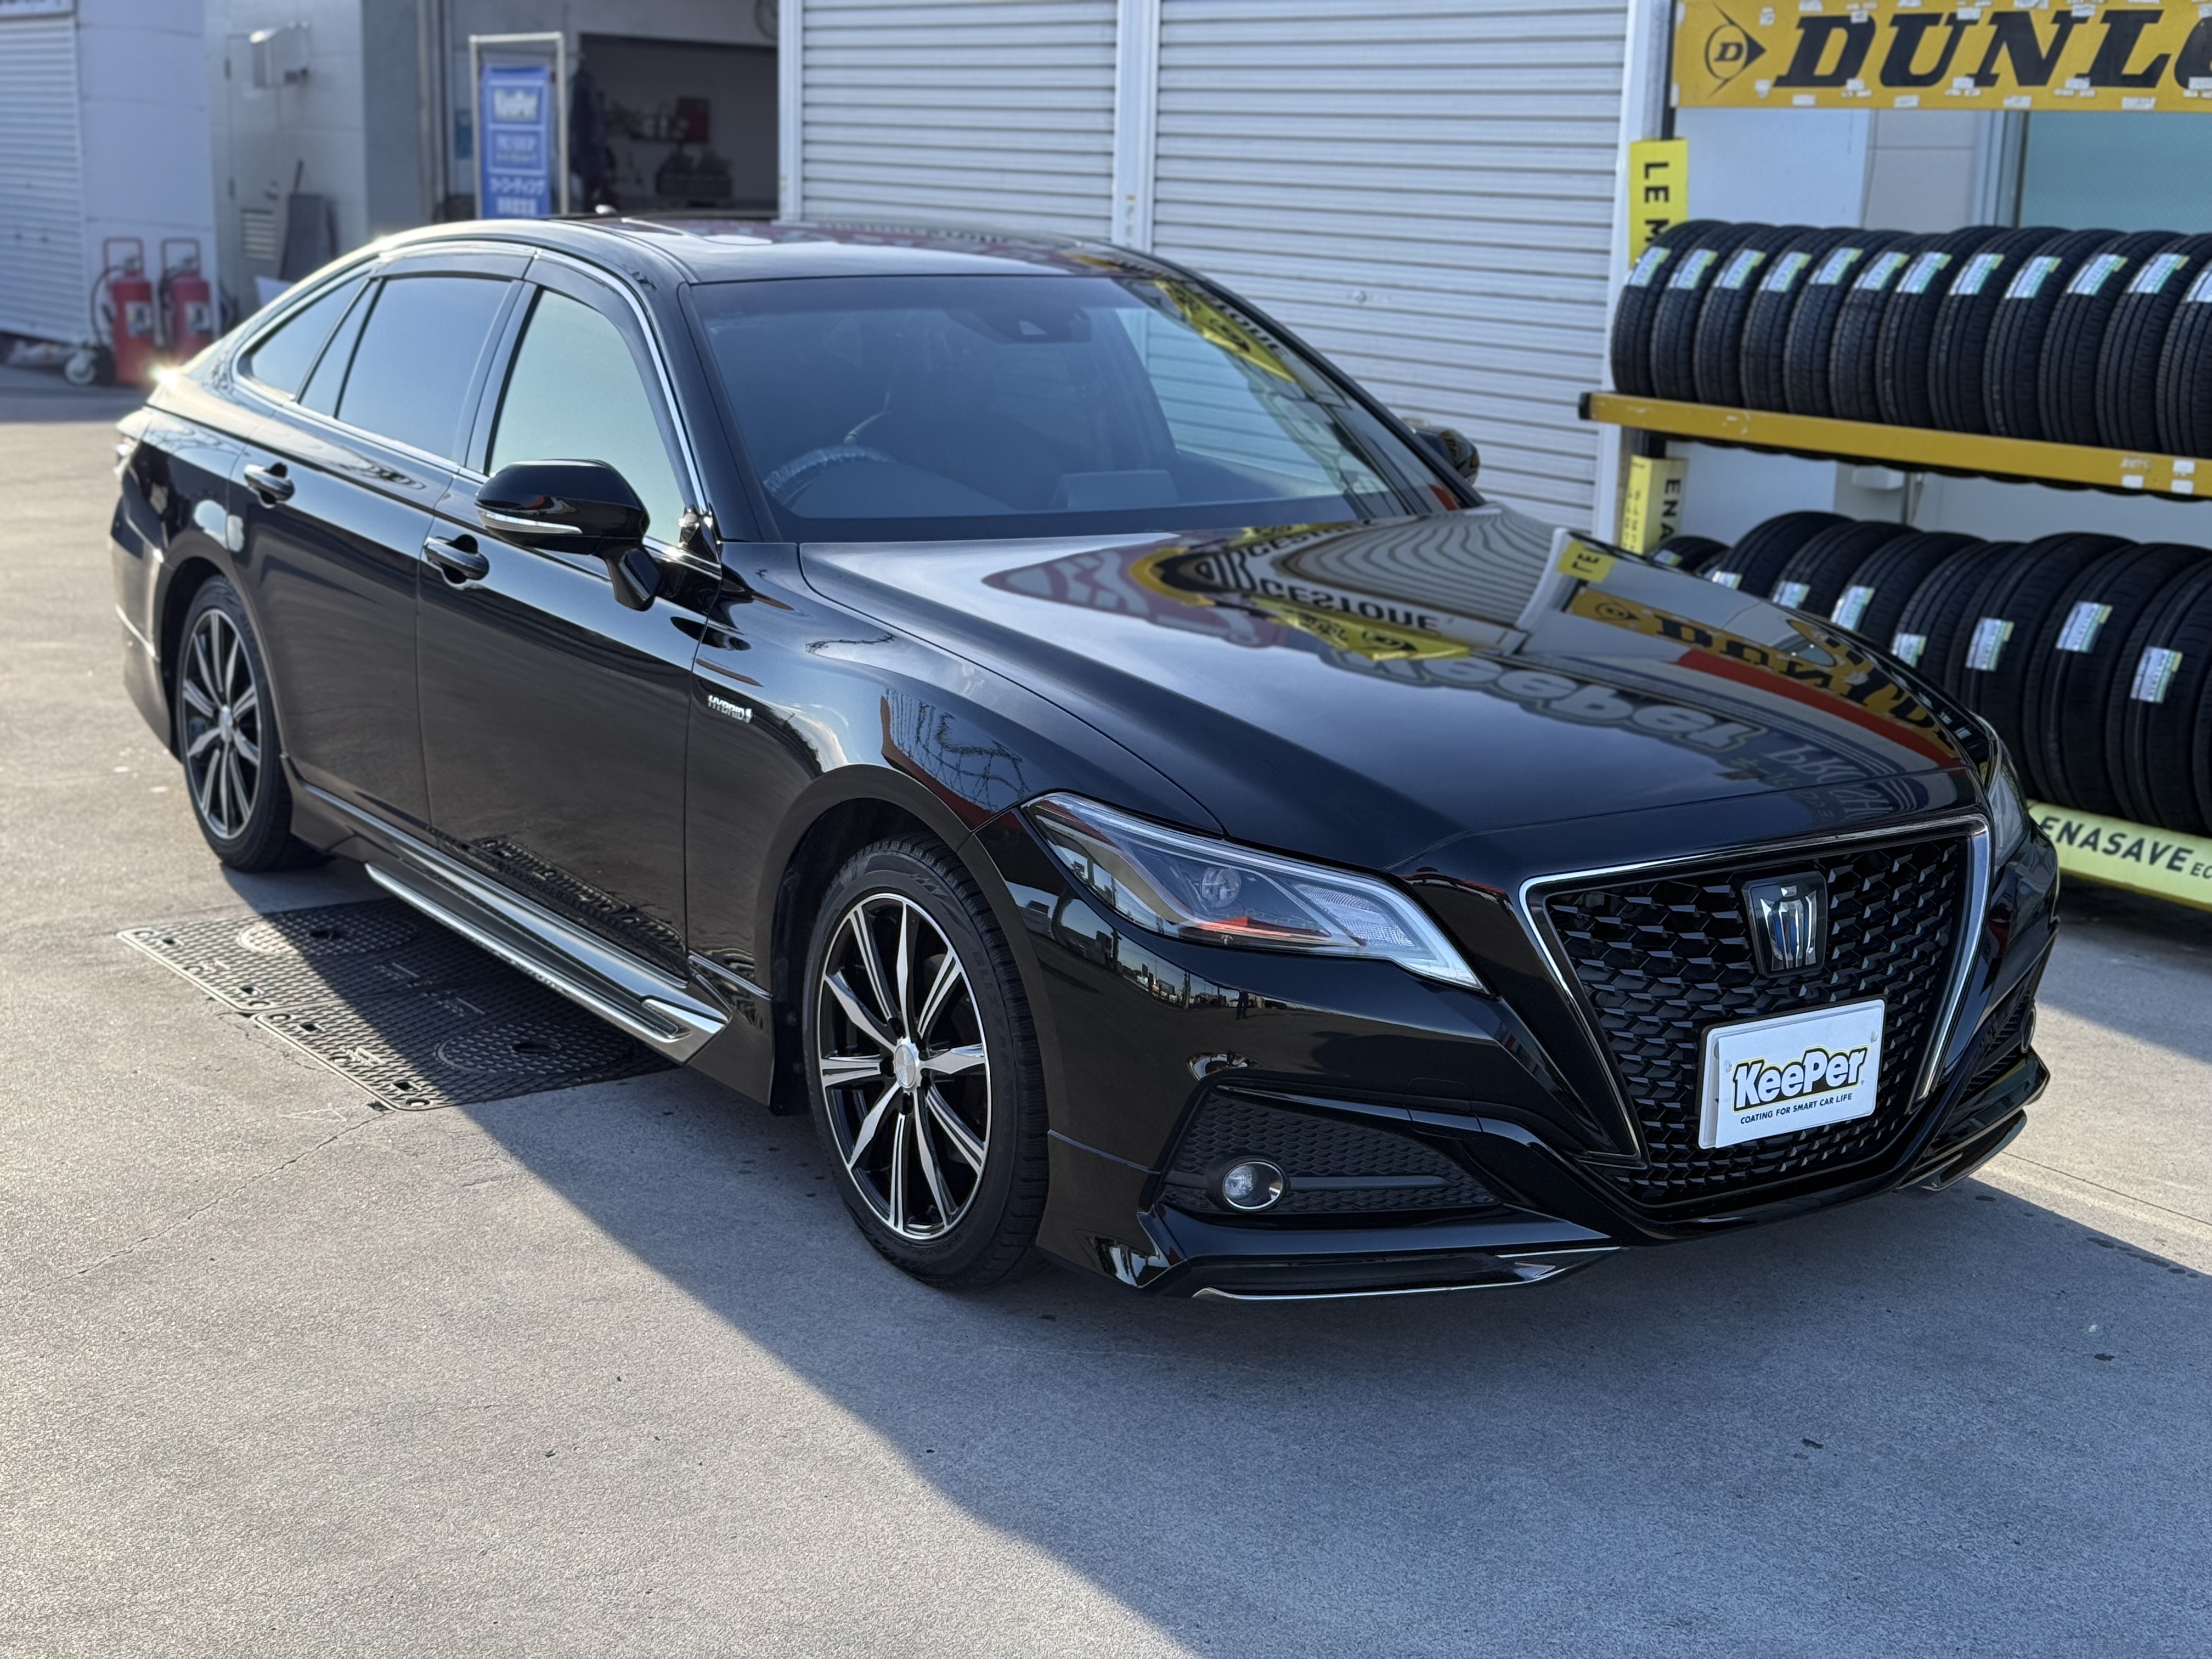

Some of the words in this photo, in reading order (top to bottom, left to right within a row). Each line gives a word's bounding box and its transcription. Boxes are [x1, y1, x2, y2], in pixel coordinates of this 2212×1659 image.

[1644, 162, 1669, 203] LE
[2038, 816, 2194, 872] ENASAVE
[1733, 1046, 1867, 1111] KeePer
[1740, 1110, 1773, 1124] COATING
[1776, 1107, 1791, 1116] FOR
[1793, 1101, 1818, 1113] SMART
[1820, 1098, 1834, 1107] CAR
[1836, 1093, 1853, 1103] LIFE
